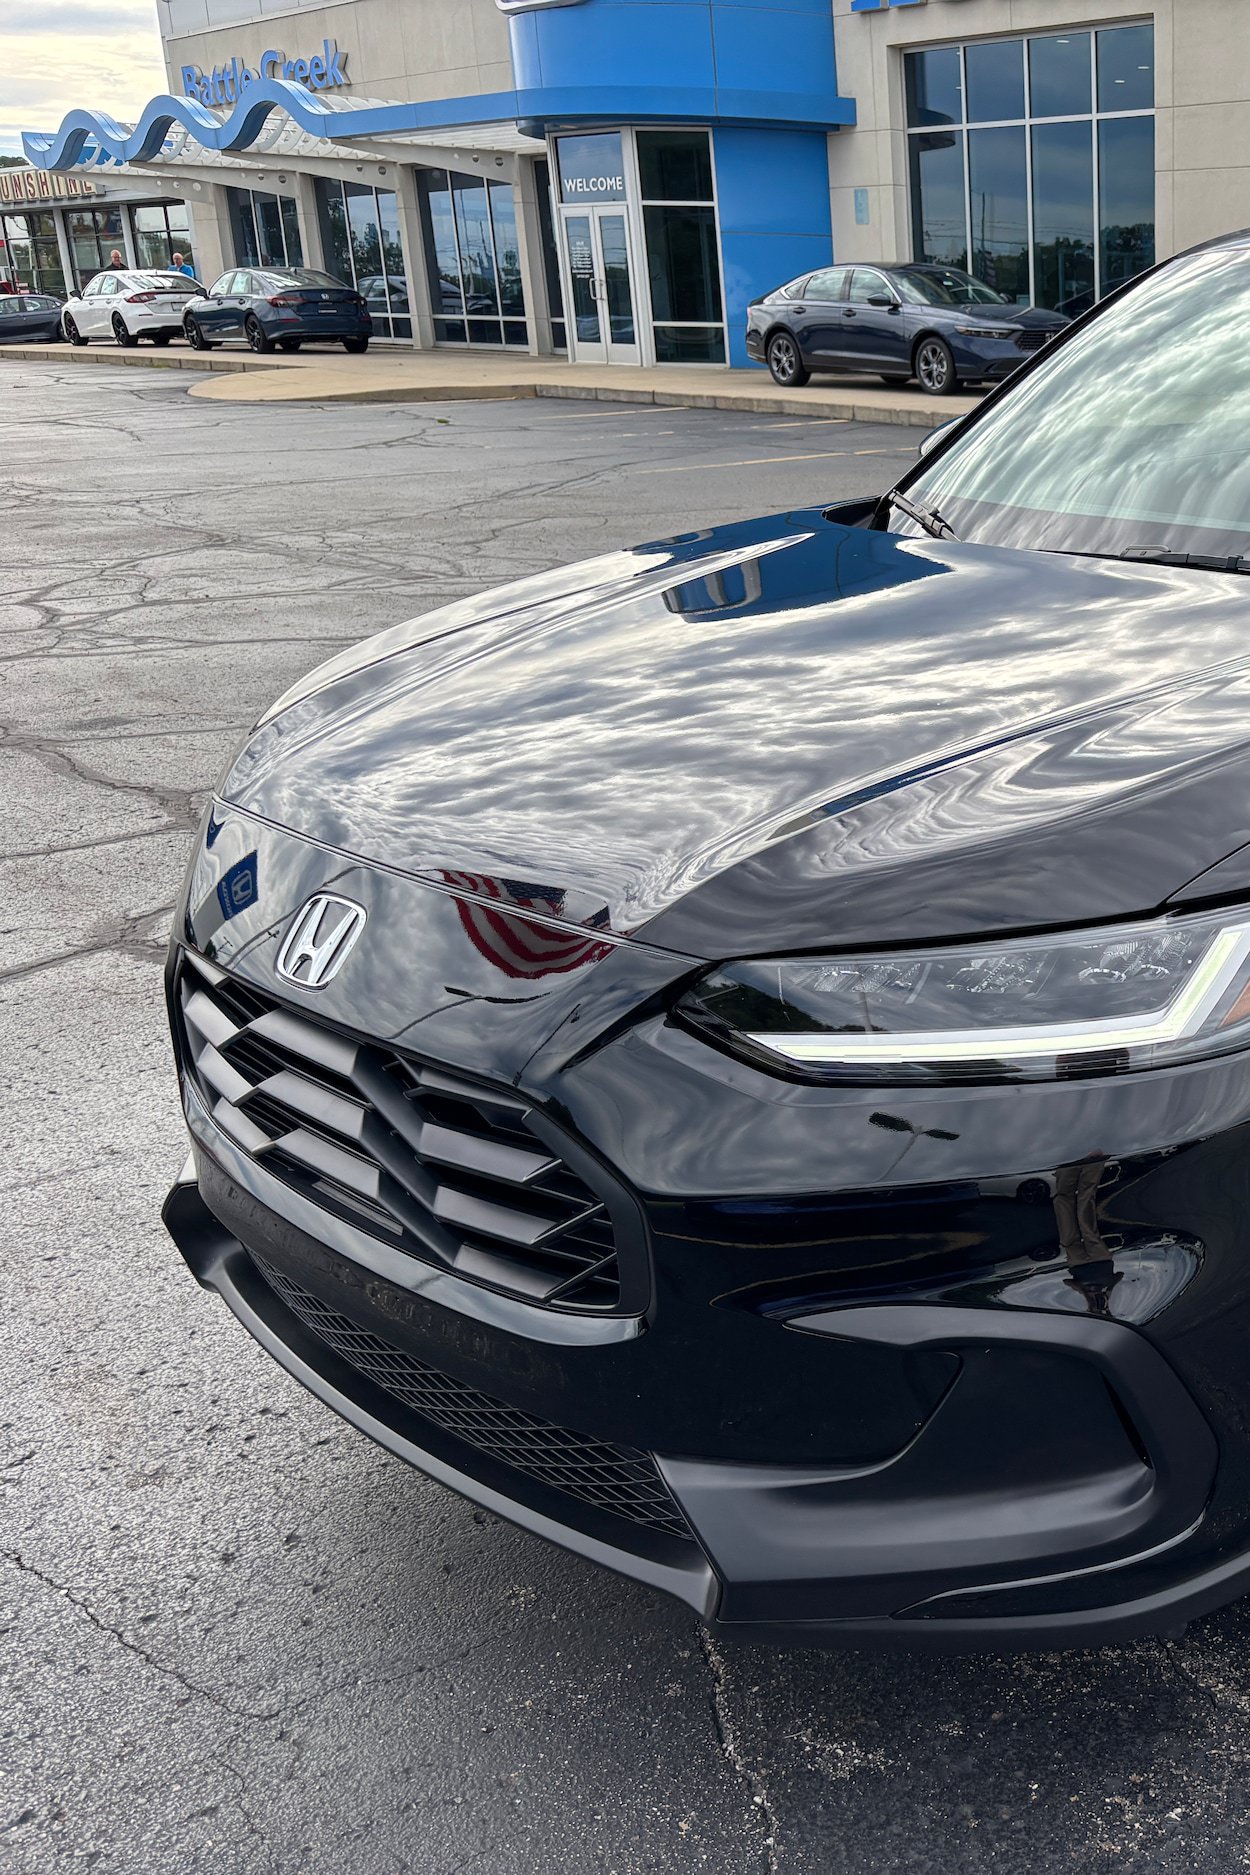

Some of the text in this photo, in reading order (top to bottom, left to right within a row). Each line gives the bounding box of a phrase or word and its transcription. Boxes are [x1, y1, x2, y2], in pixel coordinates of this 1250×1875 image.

[181, 39, 347, 106] Battle Creek
[564, 176, 623, 192] WELCOME
